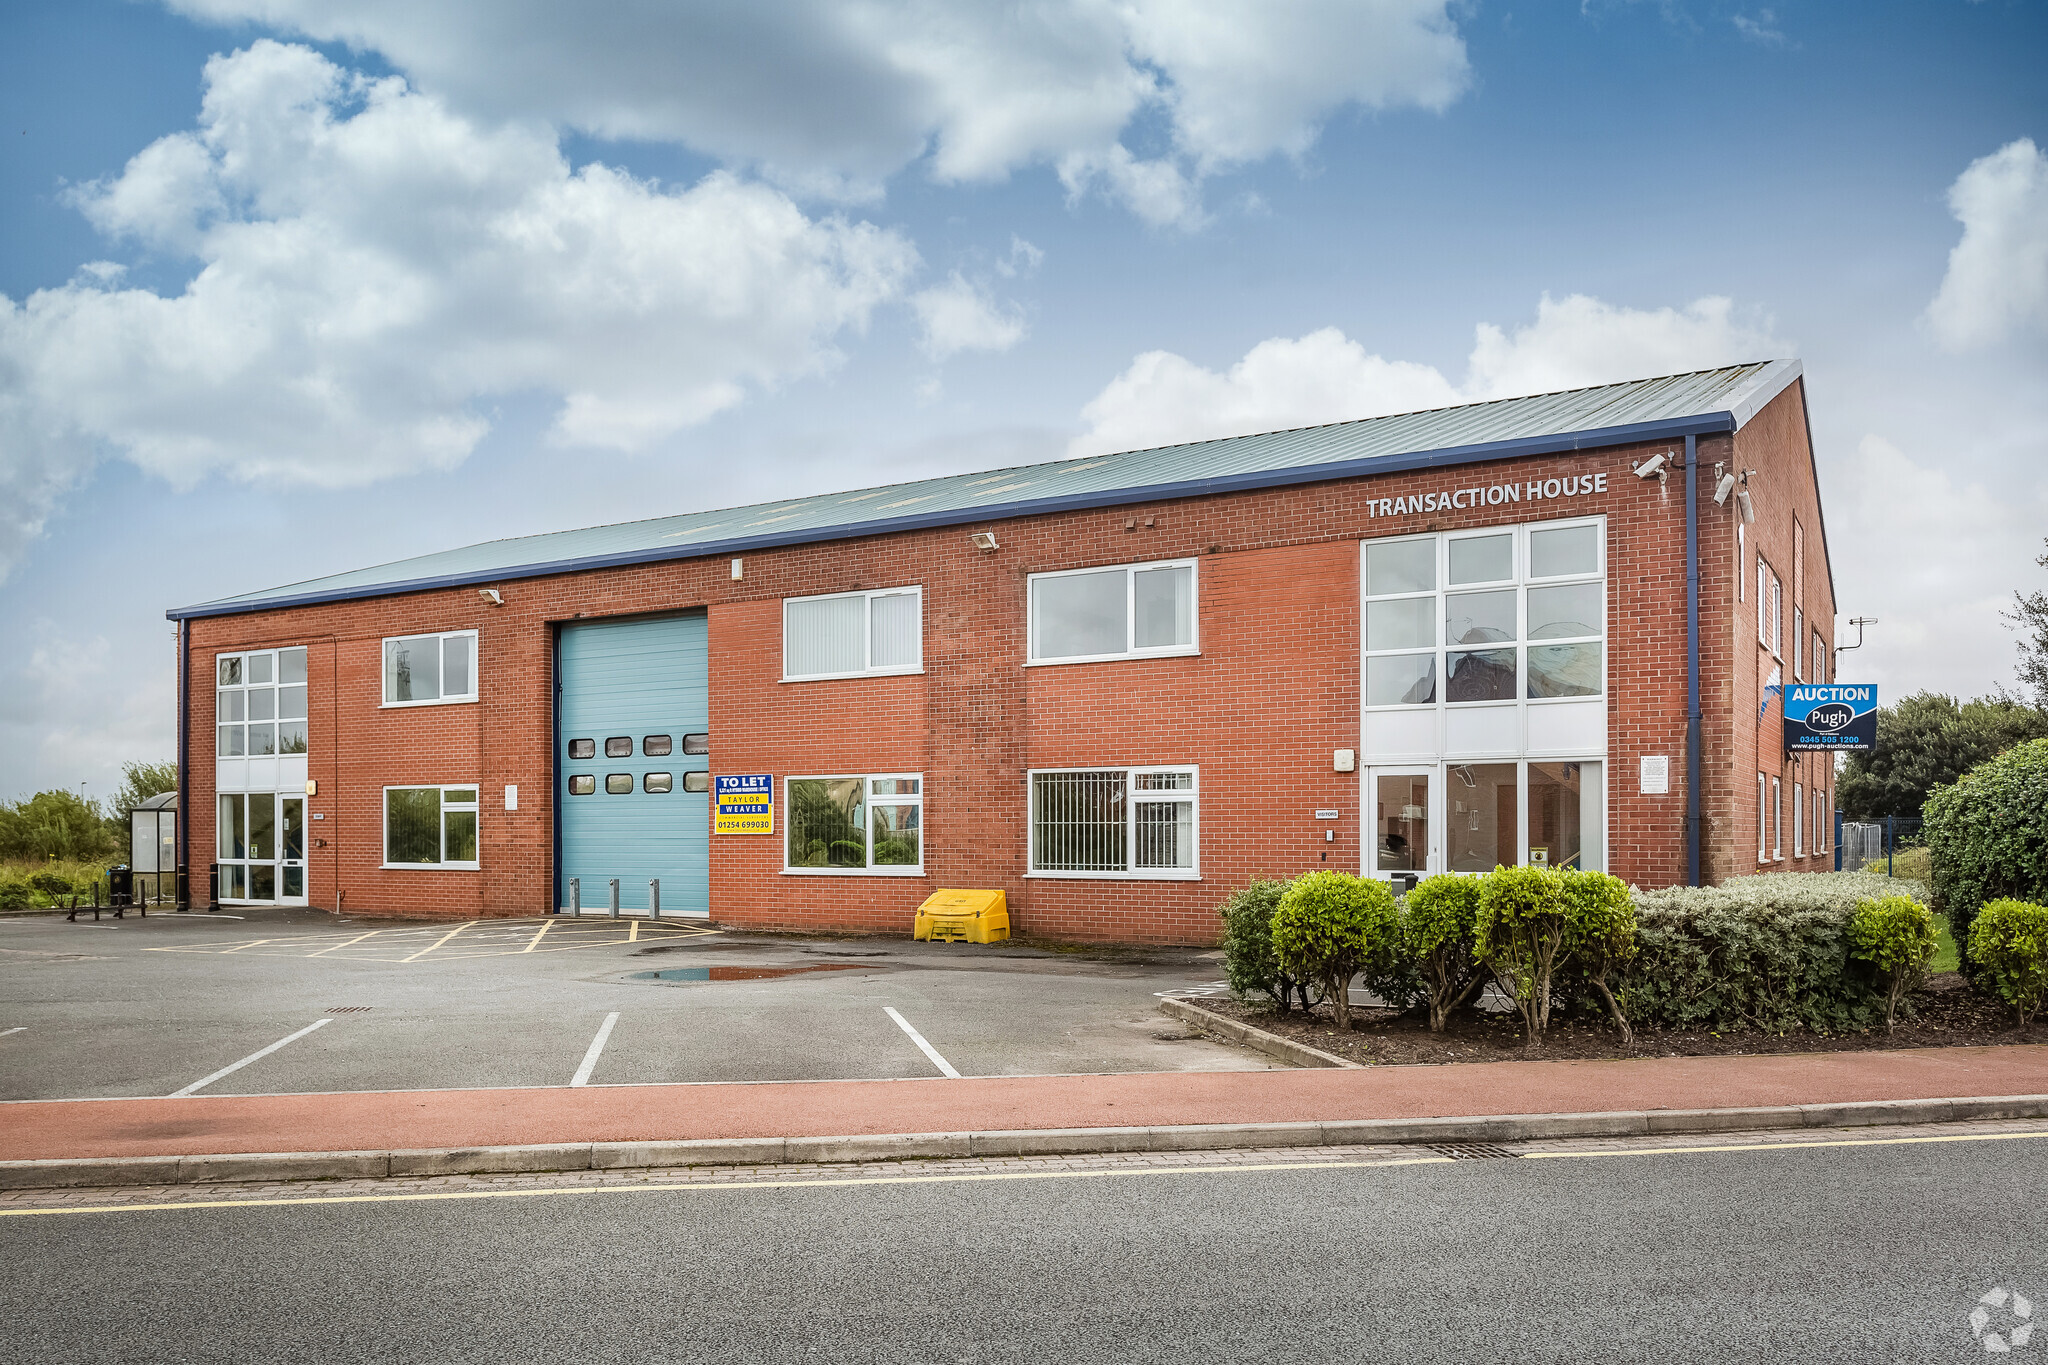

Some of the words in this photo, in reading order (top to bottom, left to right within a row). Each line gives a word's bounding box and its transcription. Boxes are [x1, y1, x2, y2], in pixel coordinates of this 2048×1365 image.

[1366, 483, 1520, 518] TRANSACTION
[1526, 473, 1608, 501] HOUSE
[1792, 687, 1870, 701] AUCTION
[1812, 710, 1847, 727] Pugh
[721, 777, 739, 787] TO
[742, 776, 766, 786] LET
